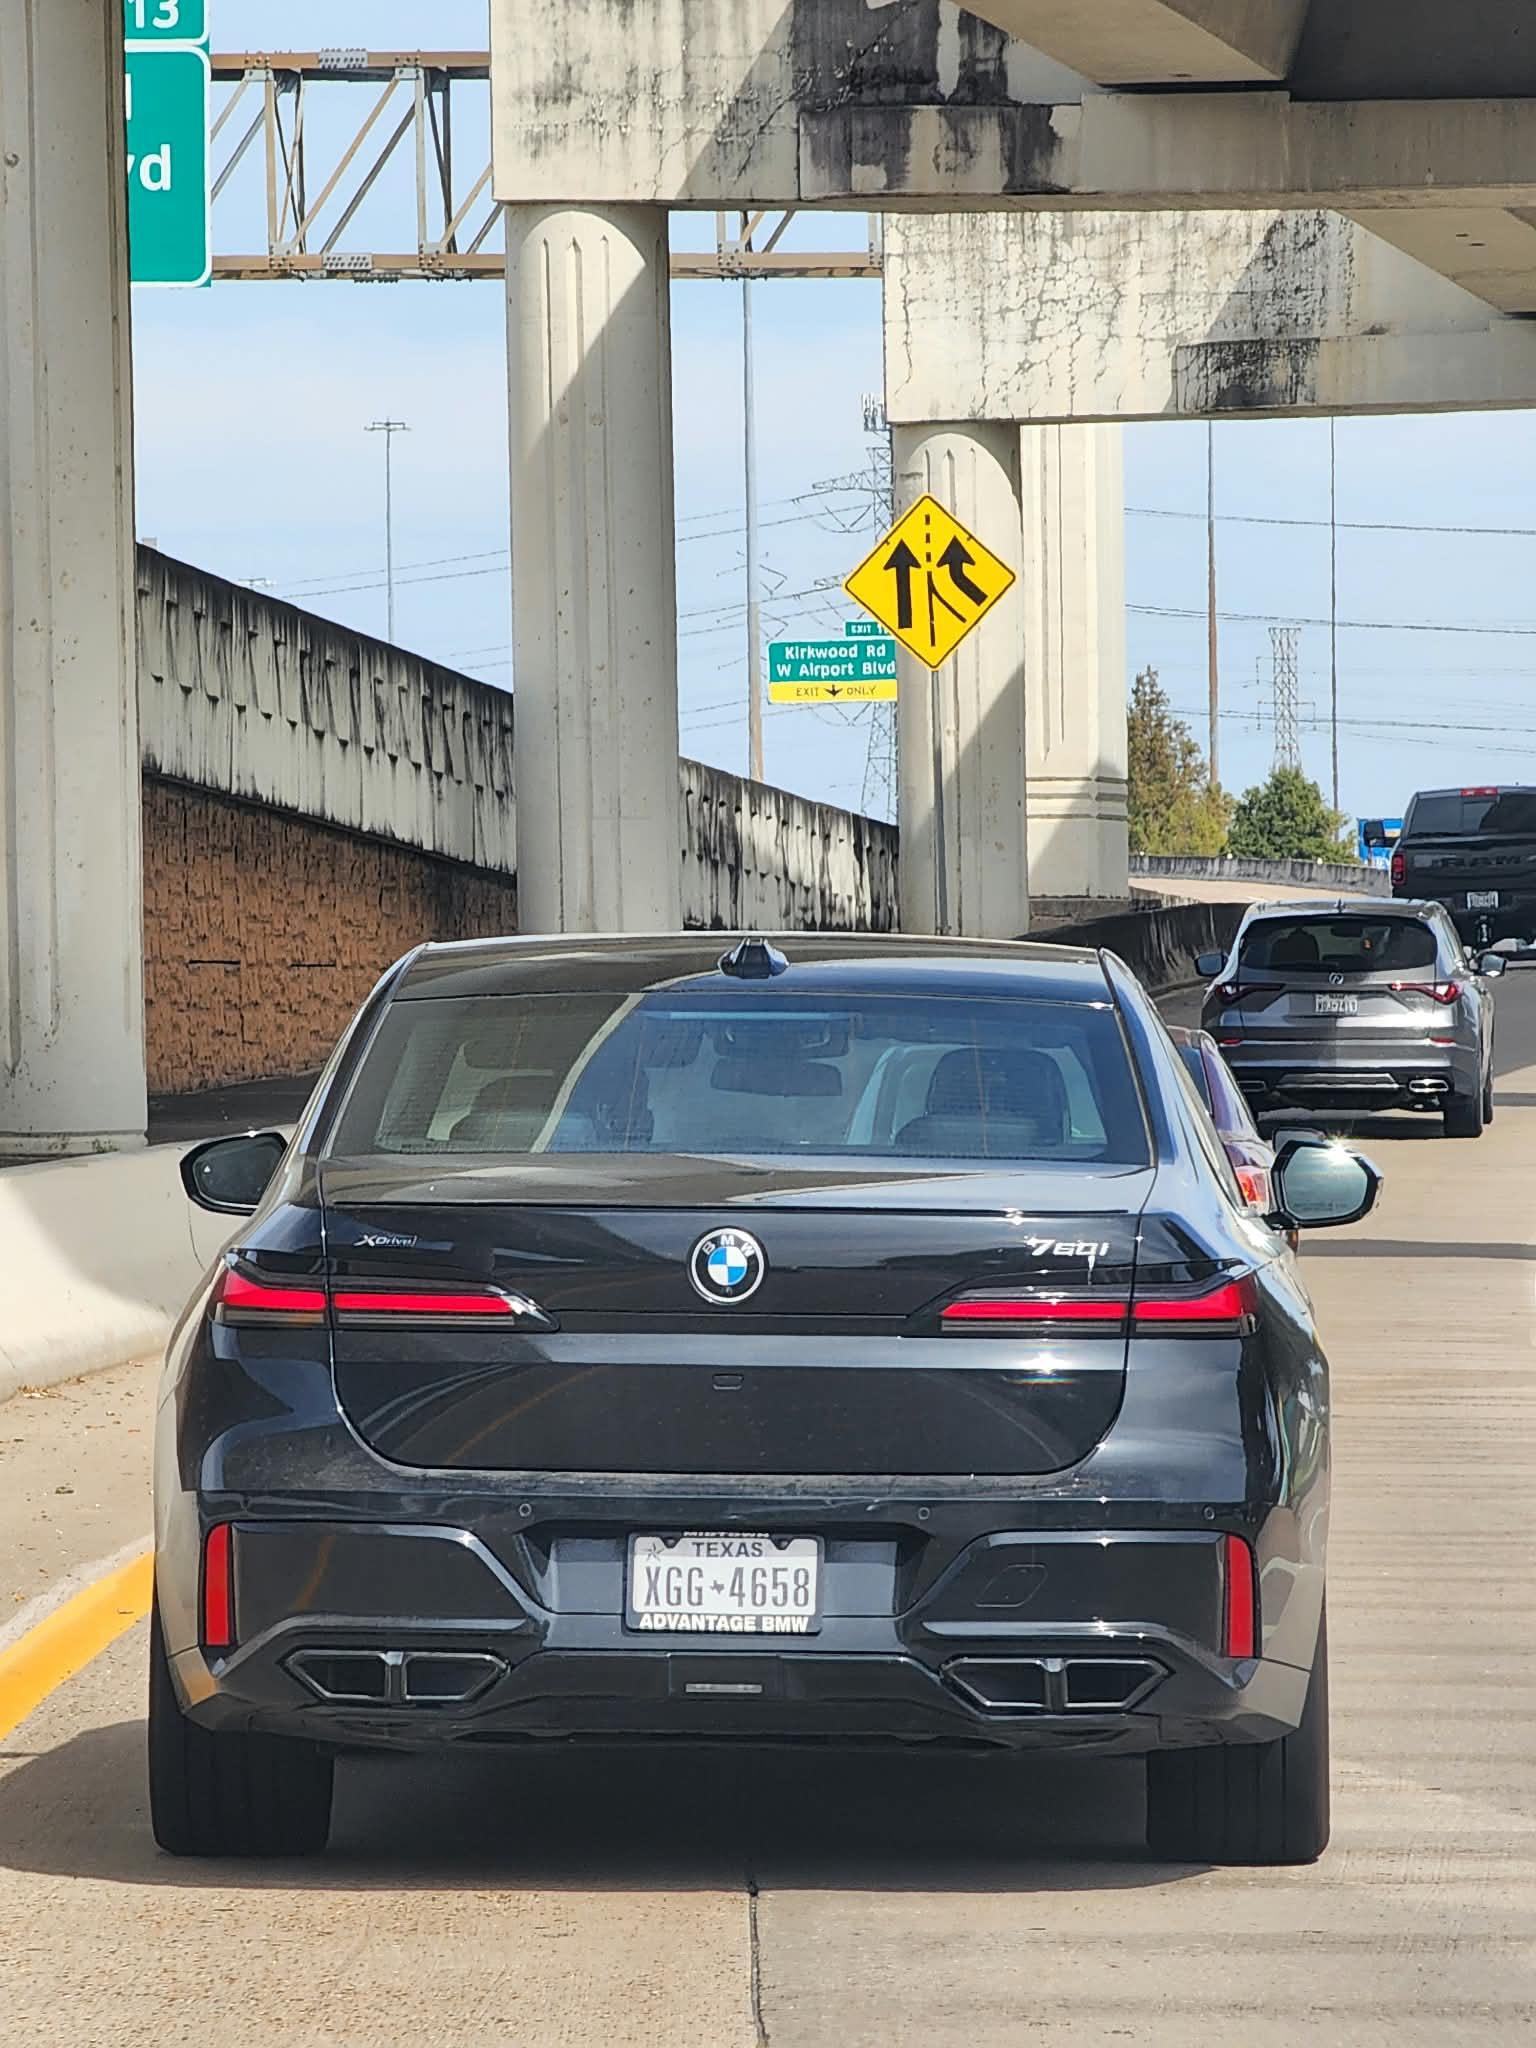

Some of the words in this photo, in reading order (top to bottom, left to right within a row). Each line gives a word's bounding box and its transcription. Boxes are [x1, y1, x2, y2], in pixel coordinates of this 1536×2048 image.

[851, 624, 871, 634] EXIT
[785, 645, 858, 660] Kirkwood
[867, 644, 886, 657] Rd
[776, 664, 792, 677] W
[800, 663, 854, 679] Airport
[862, 661, 896, 675] Blvd
[796, 687, 819, 697] EXIT
[846, 686, 876, 696] ONLY
[702, 1234, 756, 1258] BMW
[692, 1541, 763, 1558] TEXAS
[644, 1566, 704, 1607] XGG
[729, 1566, 810, 1608] 4658
[639, 1613, 756, 1631] ADVANTAGE
[761, 1615, 809, 1633] BMW
